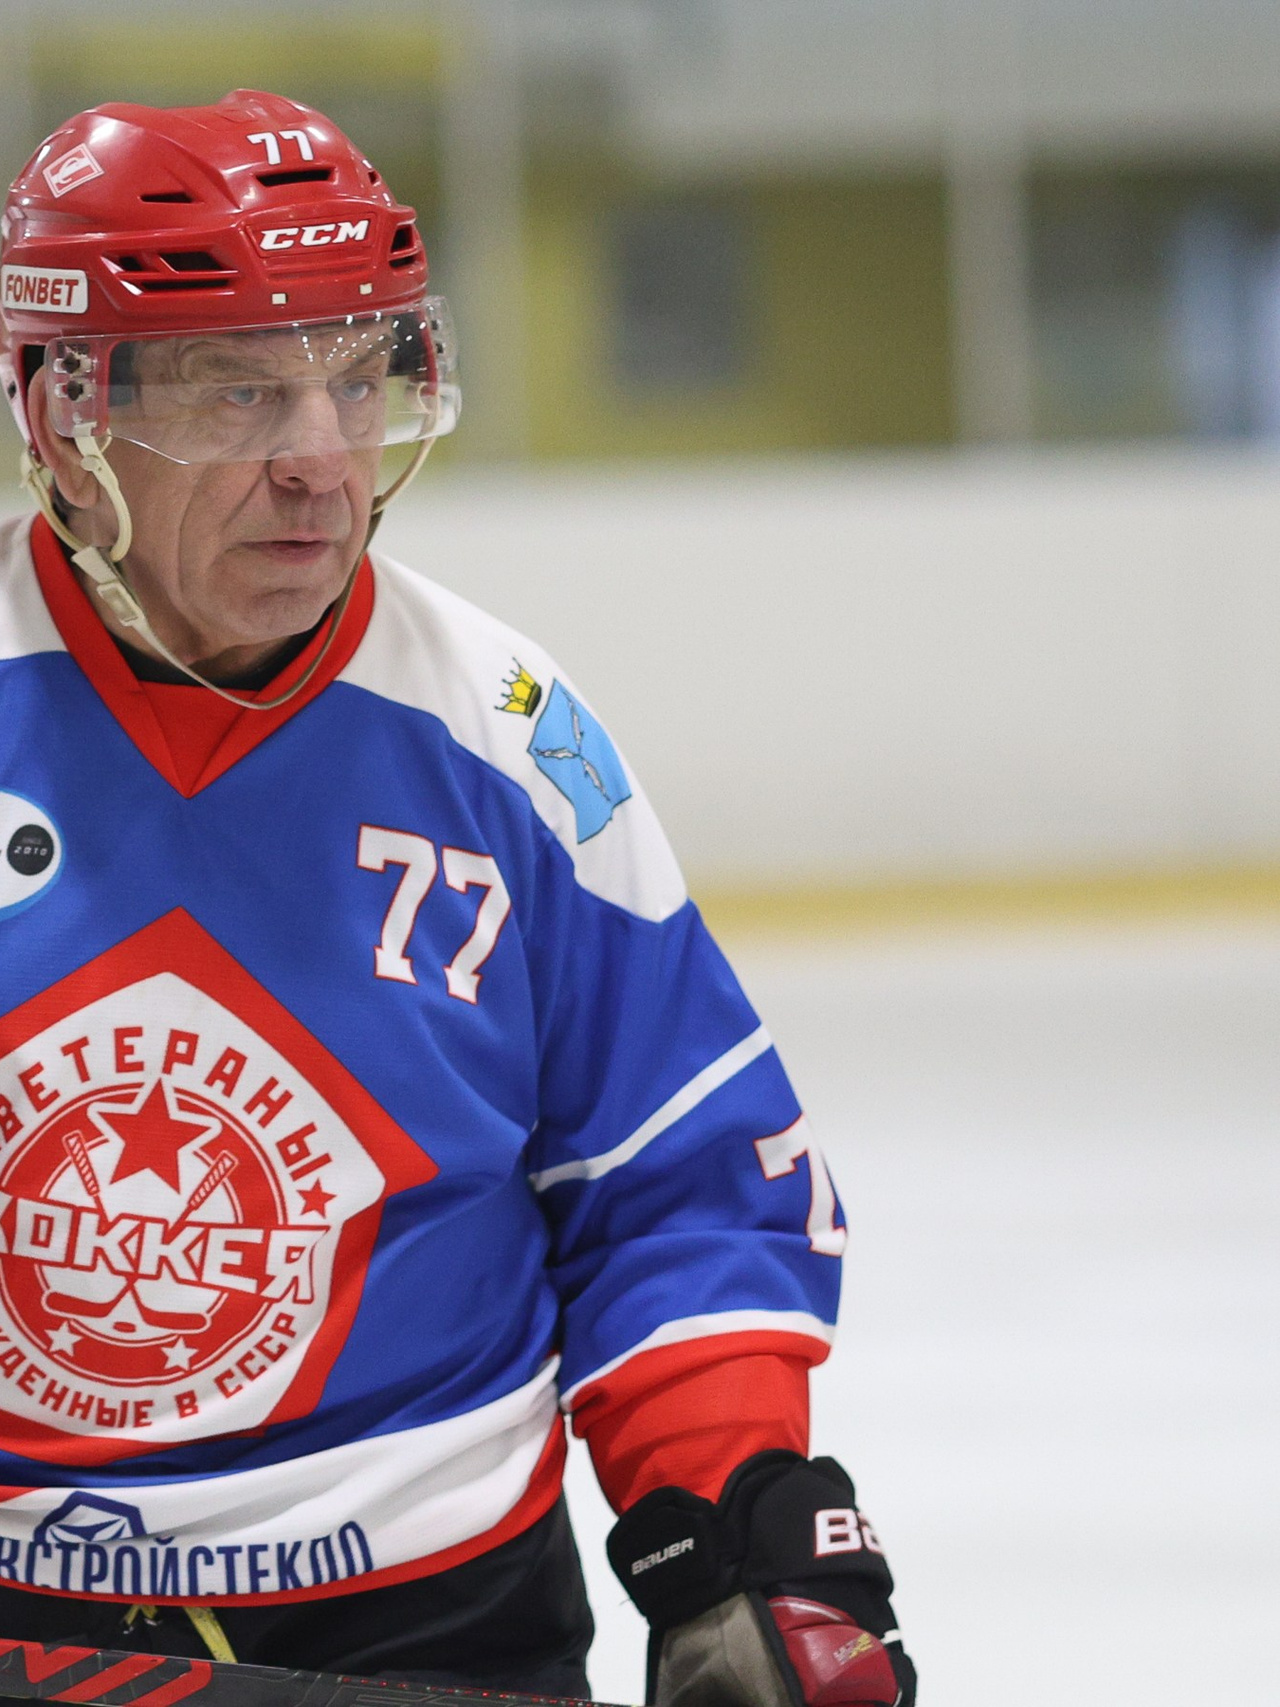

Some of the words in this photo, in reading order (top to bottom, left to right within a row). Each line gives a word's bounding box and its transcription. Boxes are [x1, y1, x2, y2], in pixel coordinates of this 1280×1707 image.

[246, 129, 315, 166] 77
[259, 219, 370, 251] CCM
[6, 273, 80, 307] FONBET
[356, 823, 512, 1006] 77
[174, 1389, 200, 1420] В
[213, 1311, 299, 1400] СССР
